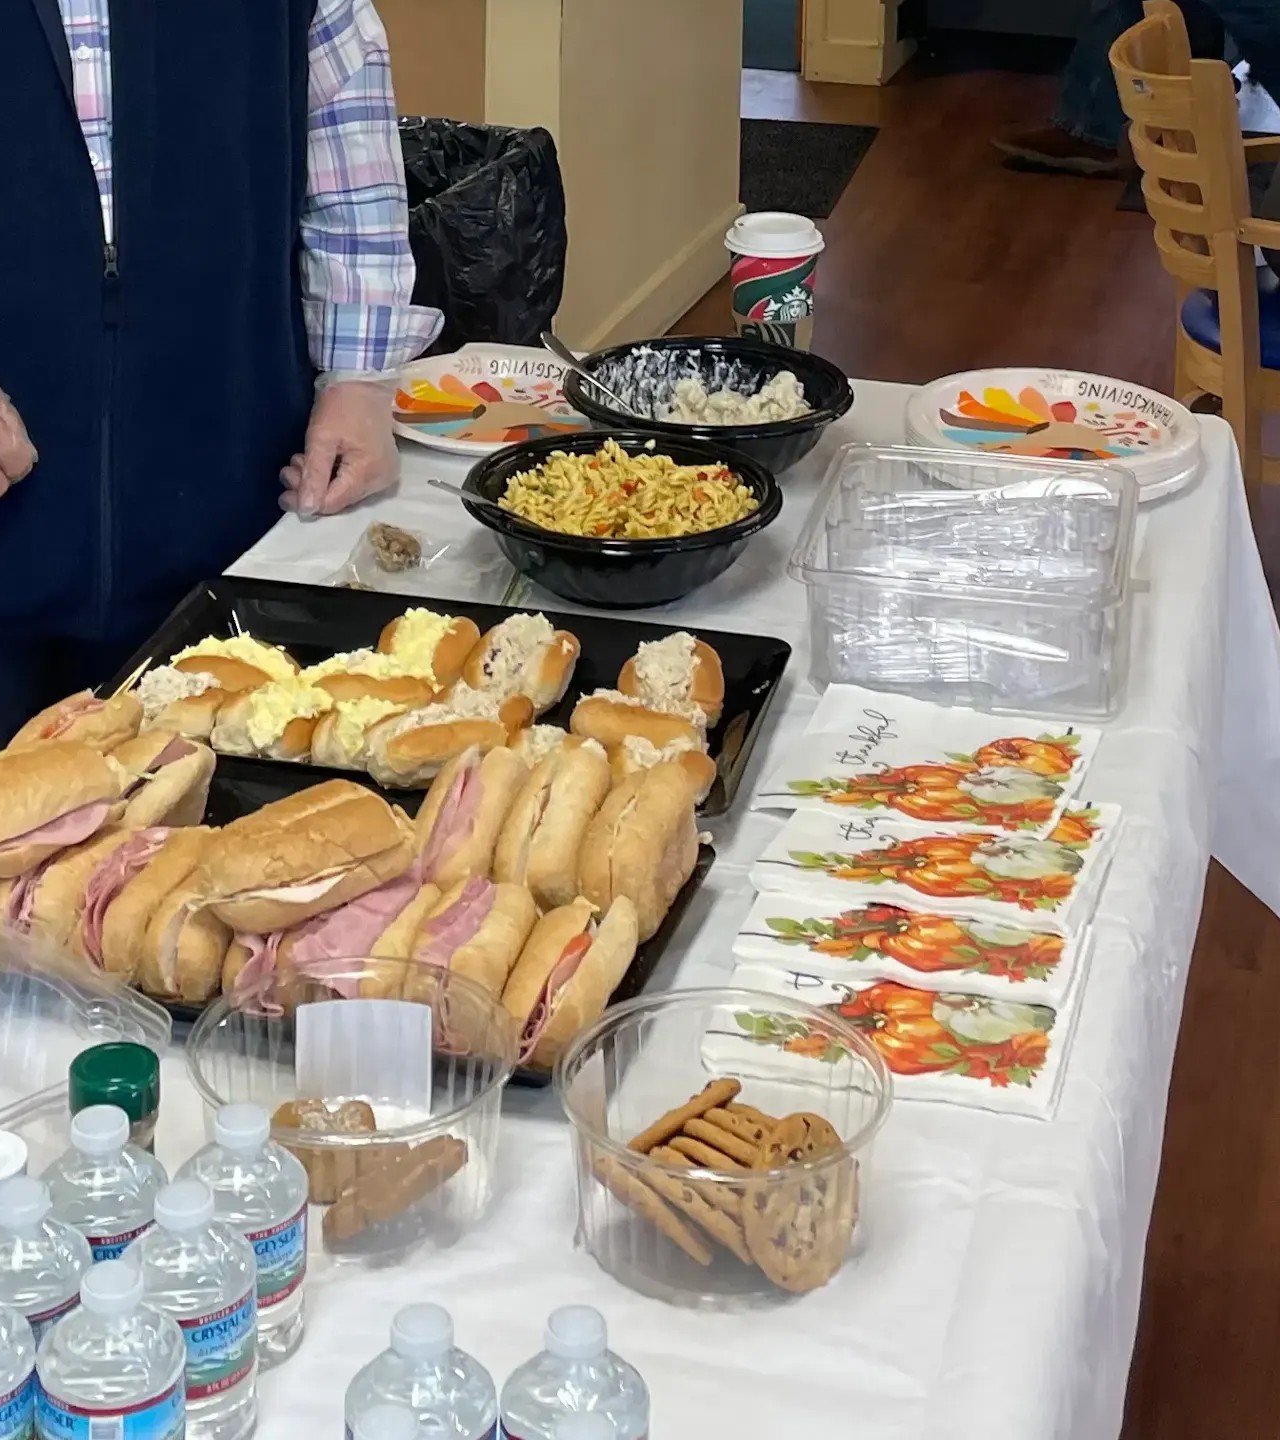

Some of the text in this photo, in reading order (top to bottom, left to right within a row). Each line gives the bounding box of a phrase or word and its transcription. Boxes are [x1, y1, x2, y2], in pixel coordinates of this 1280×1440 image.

[490, 359, 567, 381] KSGIVING
[1078, 380, 1175, 428] THANKSGIVING
[94, 1248, 123, 1261] CRYS
[191, 1317, 239, 1344] CRYSTAL
